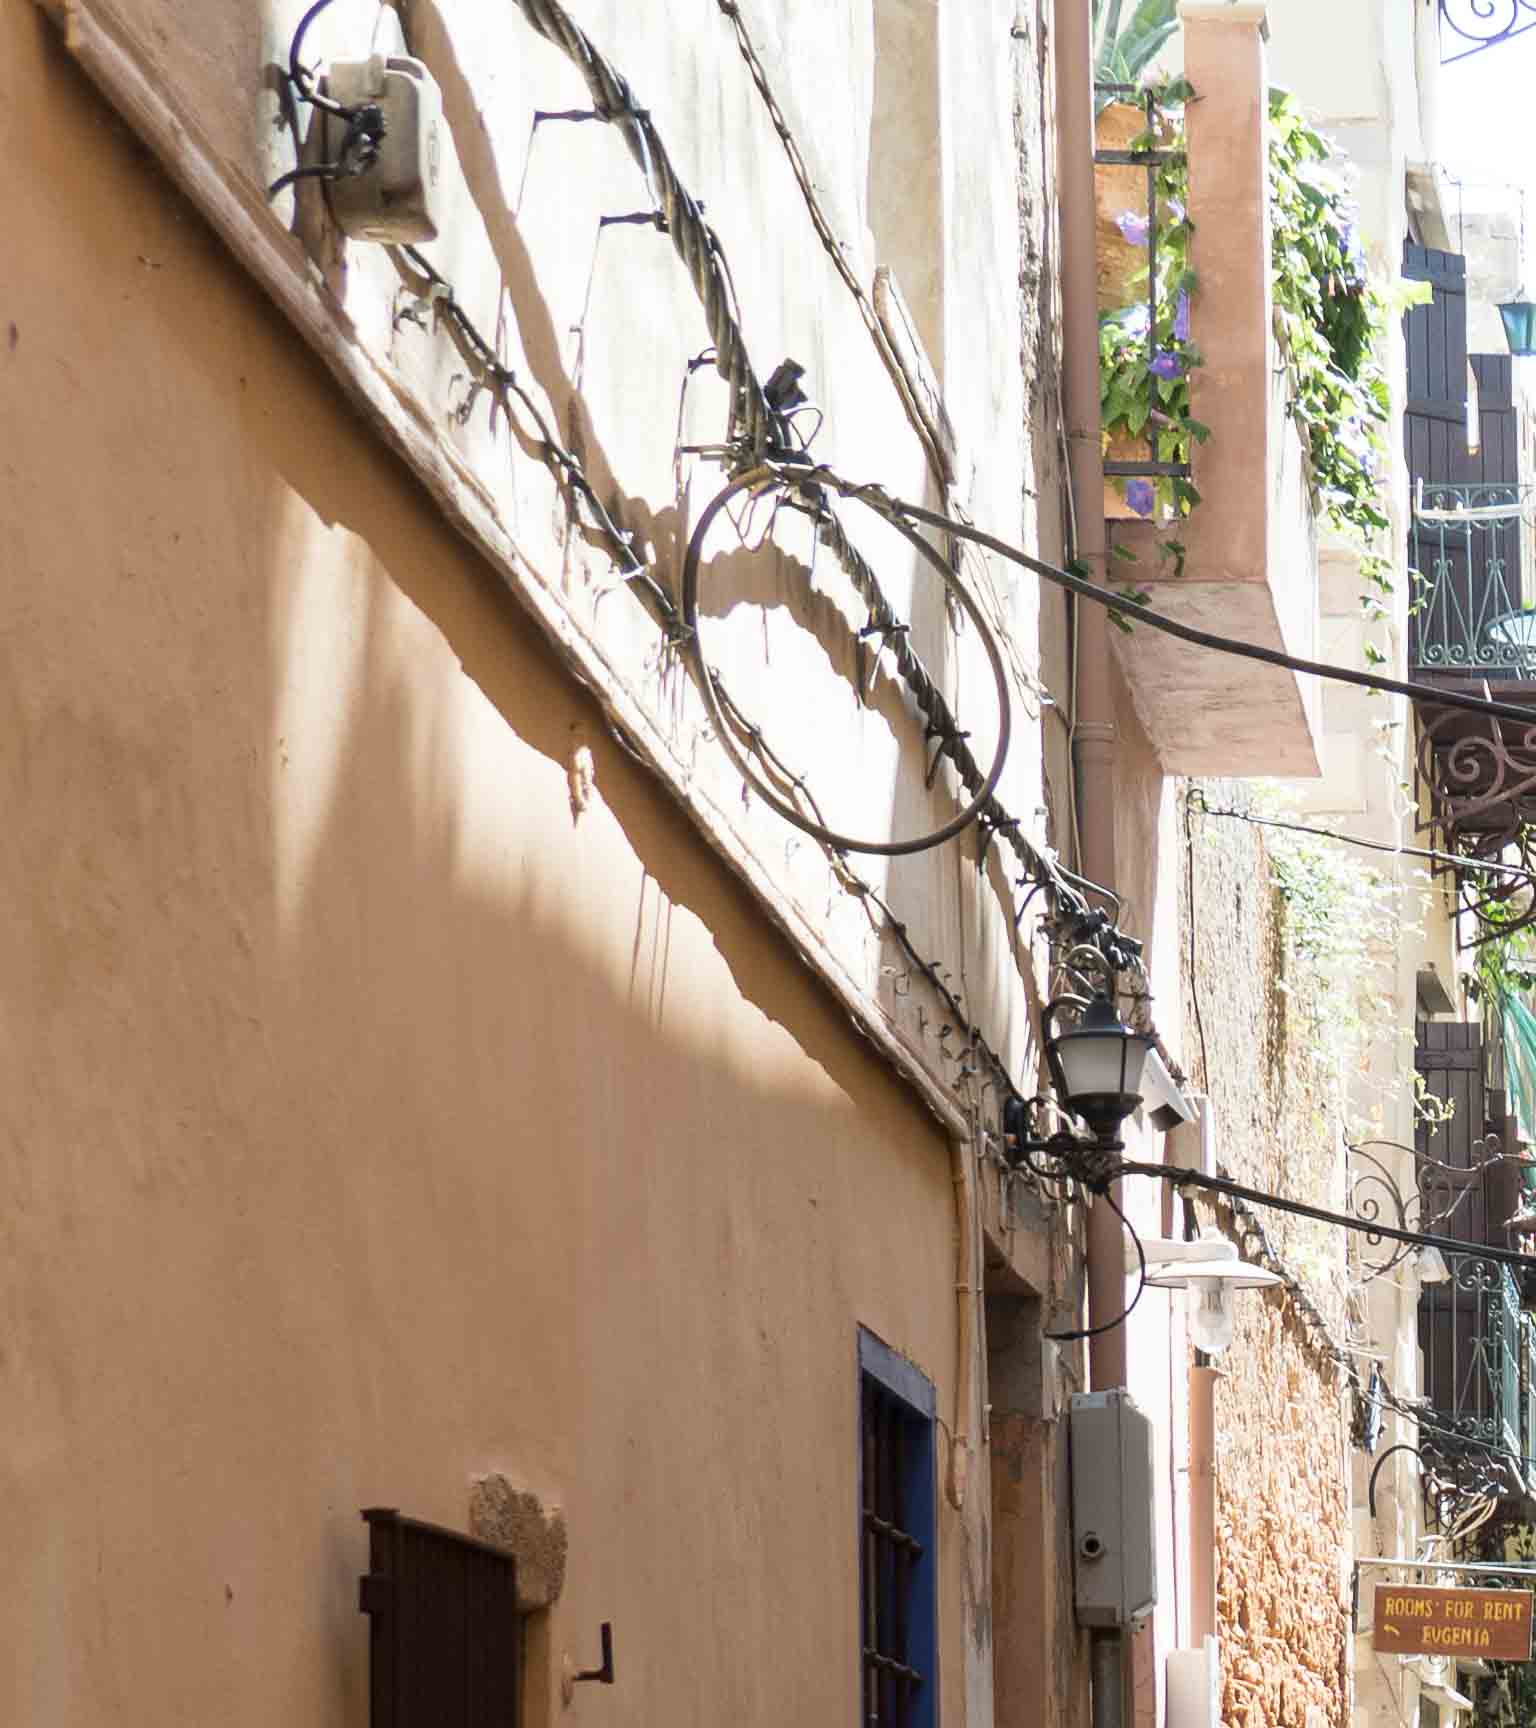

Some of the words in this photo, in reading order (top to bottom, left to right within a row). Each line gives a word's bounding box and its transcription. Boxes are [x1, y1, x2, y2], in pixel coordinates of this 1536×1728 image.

[1386, 1598, 1433, 1617] ROOMS
[1445, 1600, 1472, 1618] FOR
[1484, 1601, 1523, 1621] RENT
